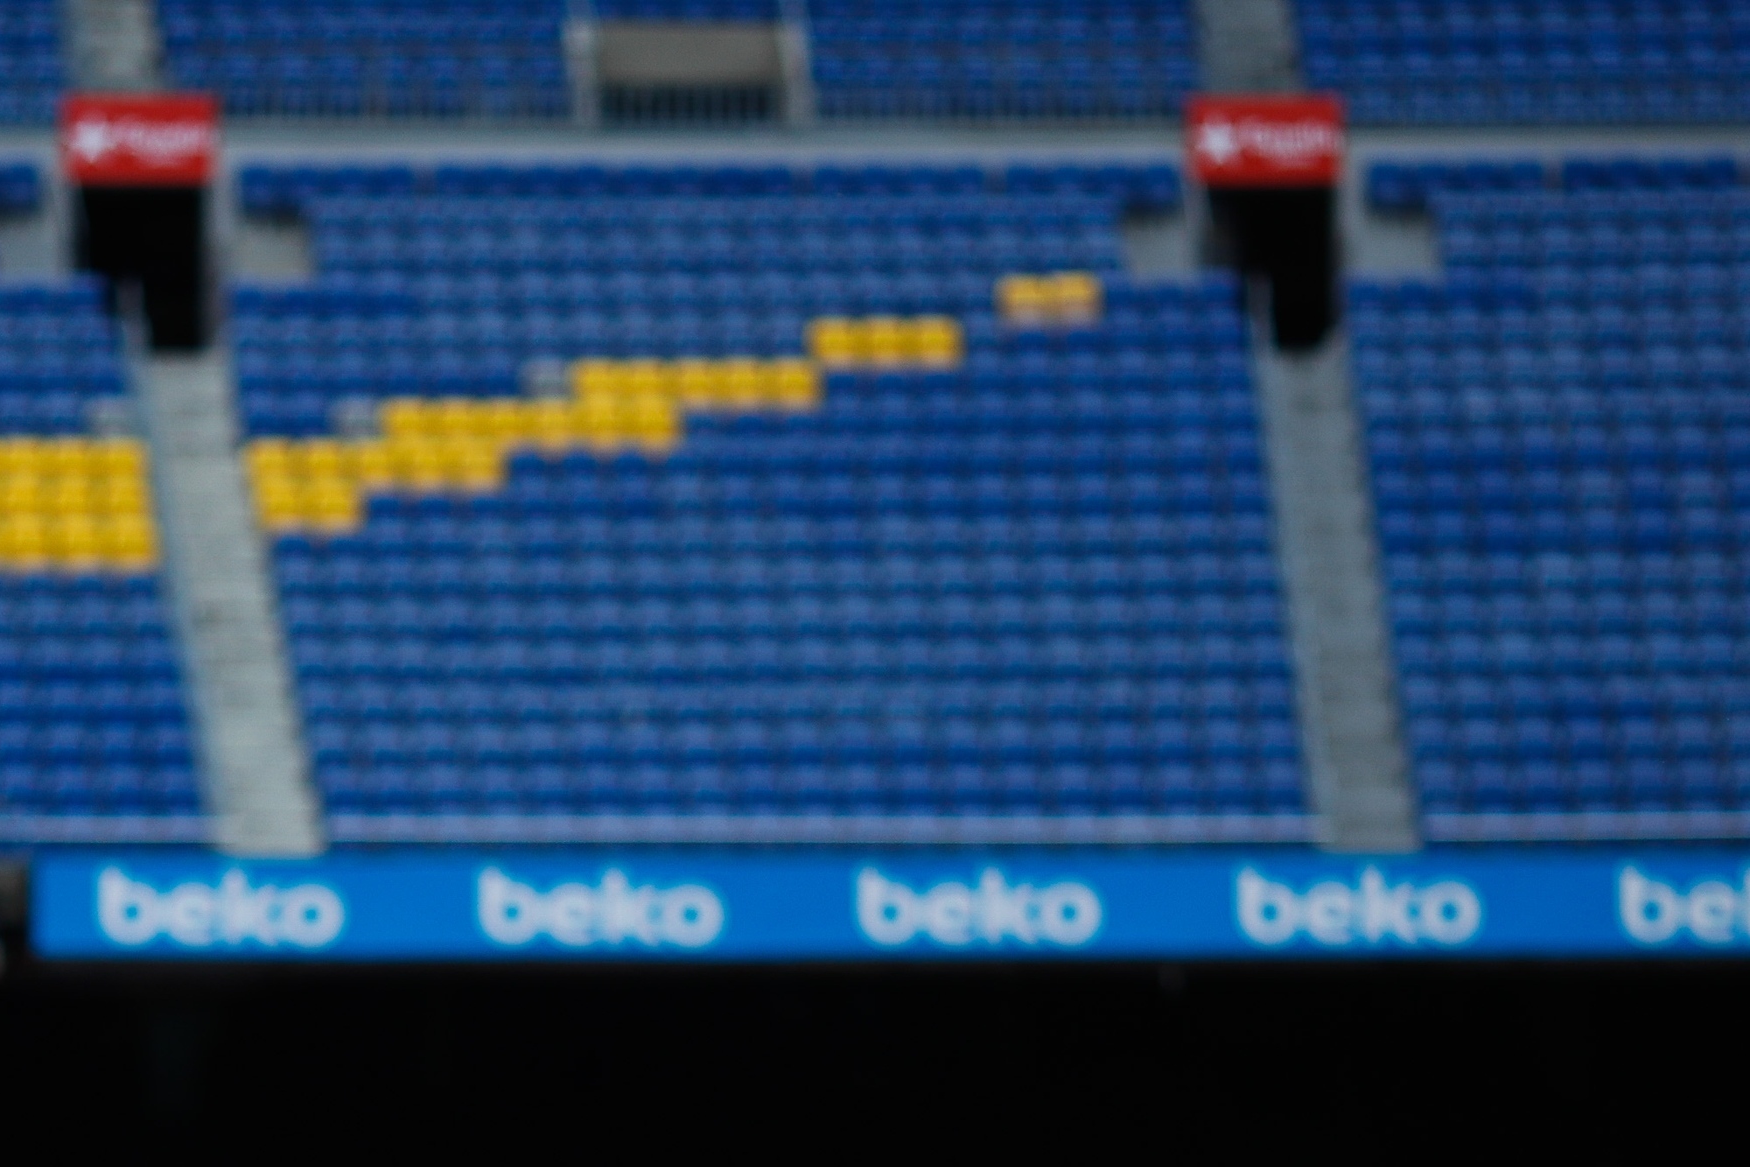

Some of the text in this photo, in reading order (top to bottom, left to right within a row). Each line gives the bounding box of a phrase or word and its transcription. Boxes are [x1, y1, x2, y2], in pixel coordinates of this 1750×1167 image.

[97, 866, 1750, 947] beko beko beko beko be
